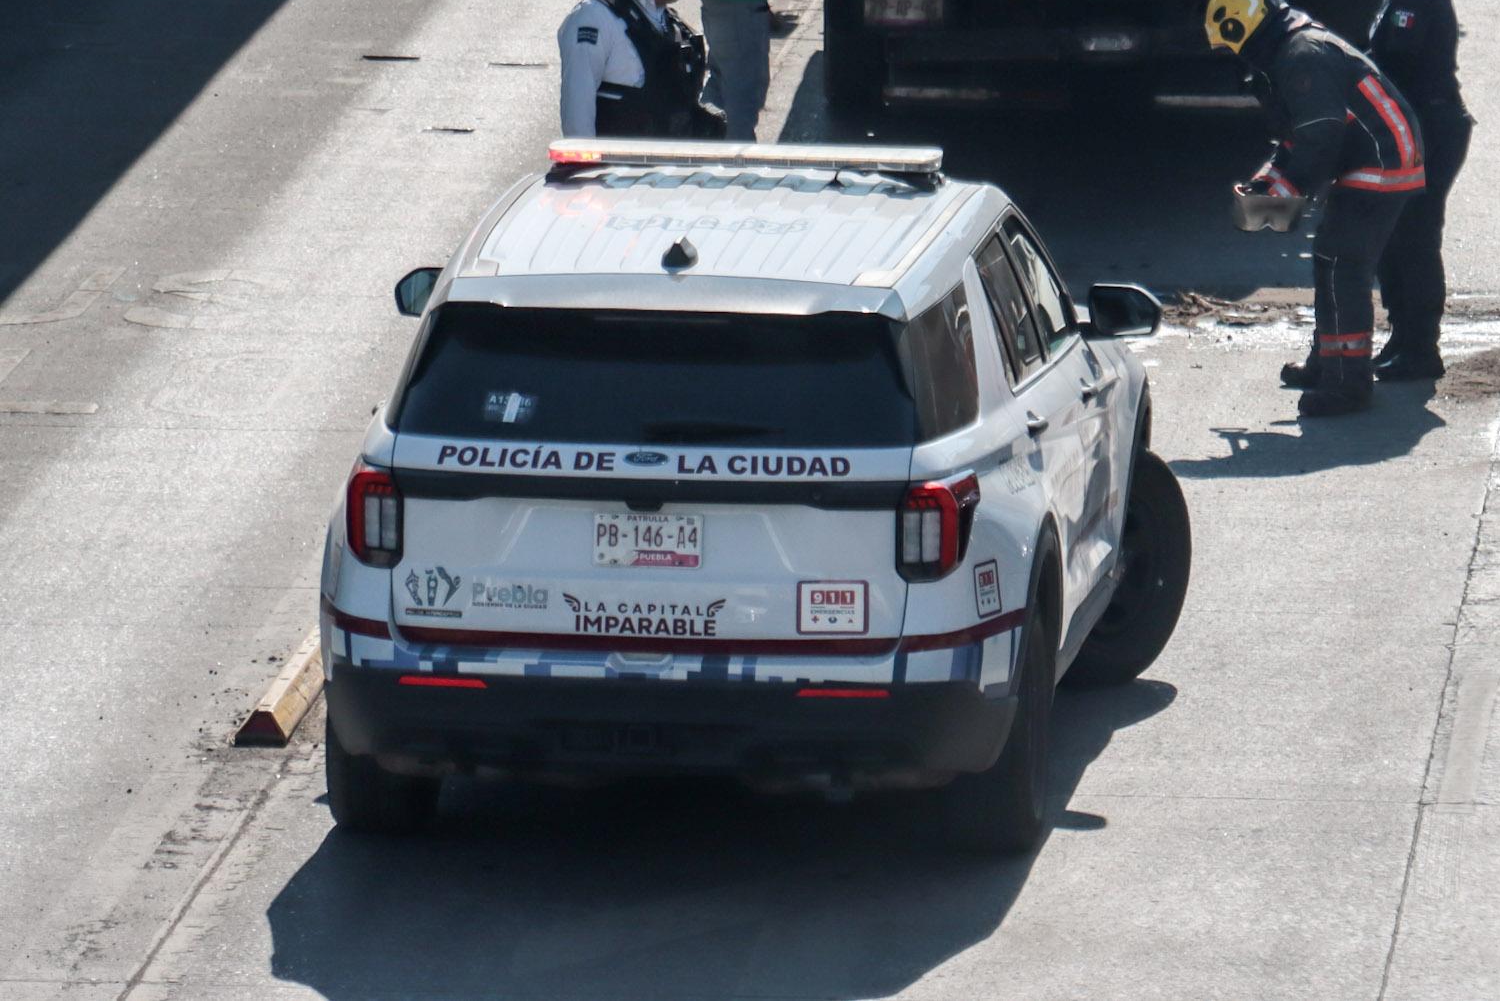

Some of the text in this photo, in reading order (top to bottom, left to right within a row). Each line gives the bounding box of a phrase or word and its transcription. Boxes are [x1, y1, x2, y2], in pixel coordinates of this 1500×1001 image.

[437, 445, 850, 476] POLICÍA DE LA CIUDAD
[596, 523, 698, 549] PB-146-A4
[637, 551, 672, 560] PUEBLA
[472, 582, 549, 604] Puebla
[811, 590, 855, 605] 911
[584, 602, 704, 616] LA CAPITAL
[575, 615, 716, 636] IMPARABLE
